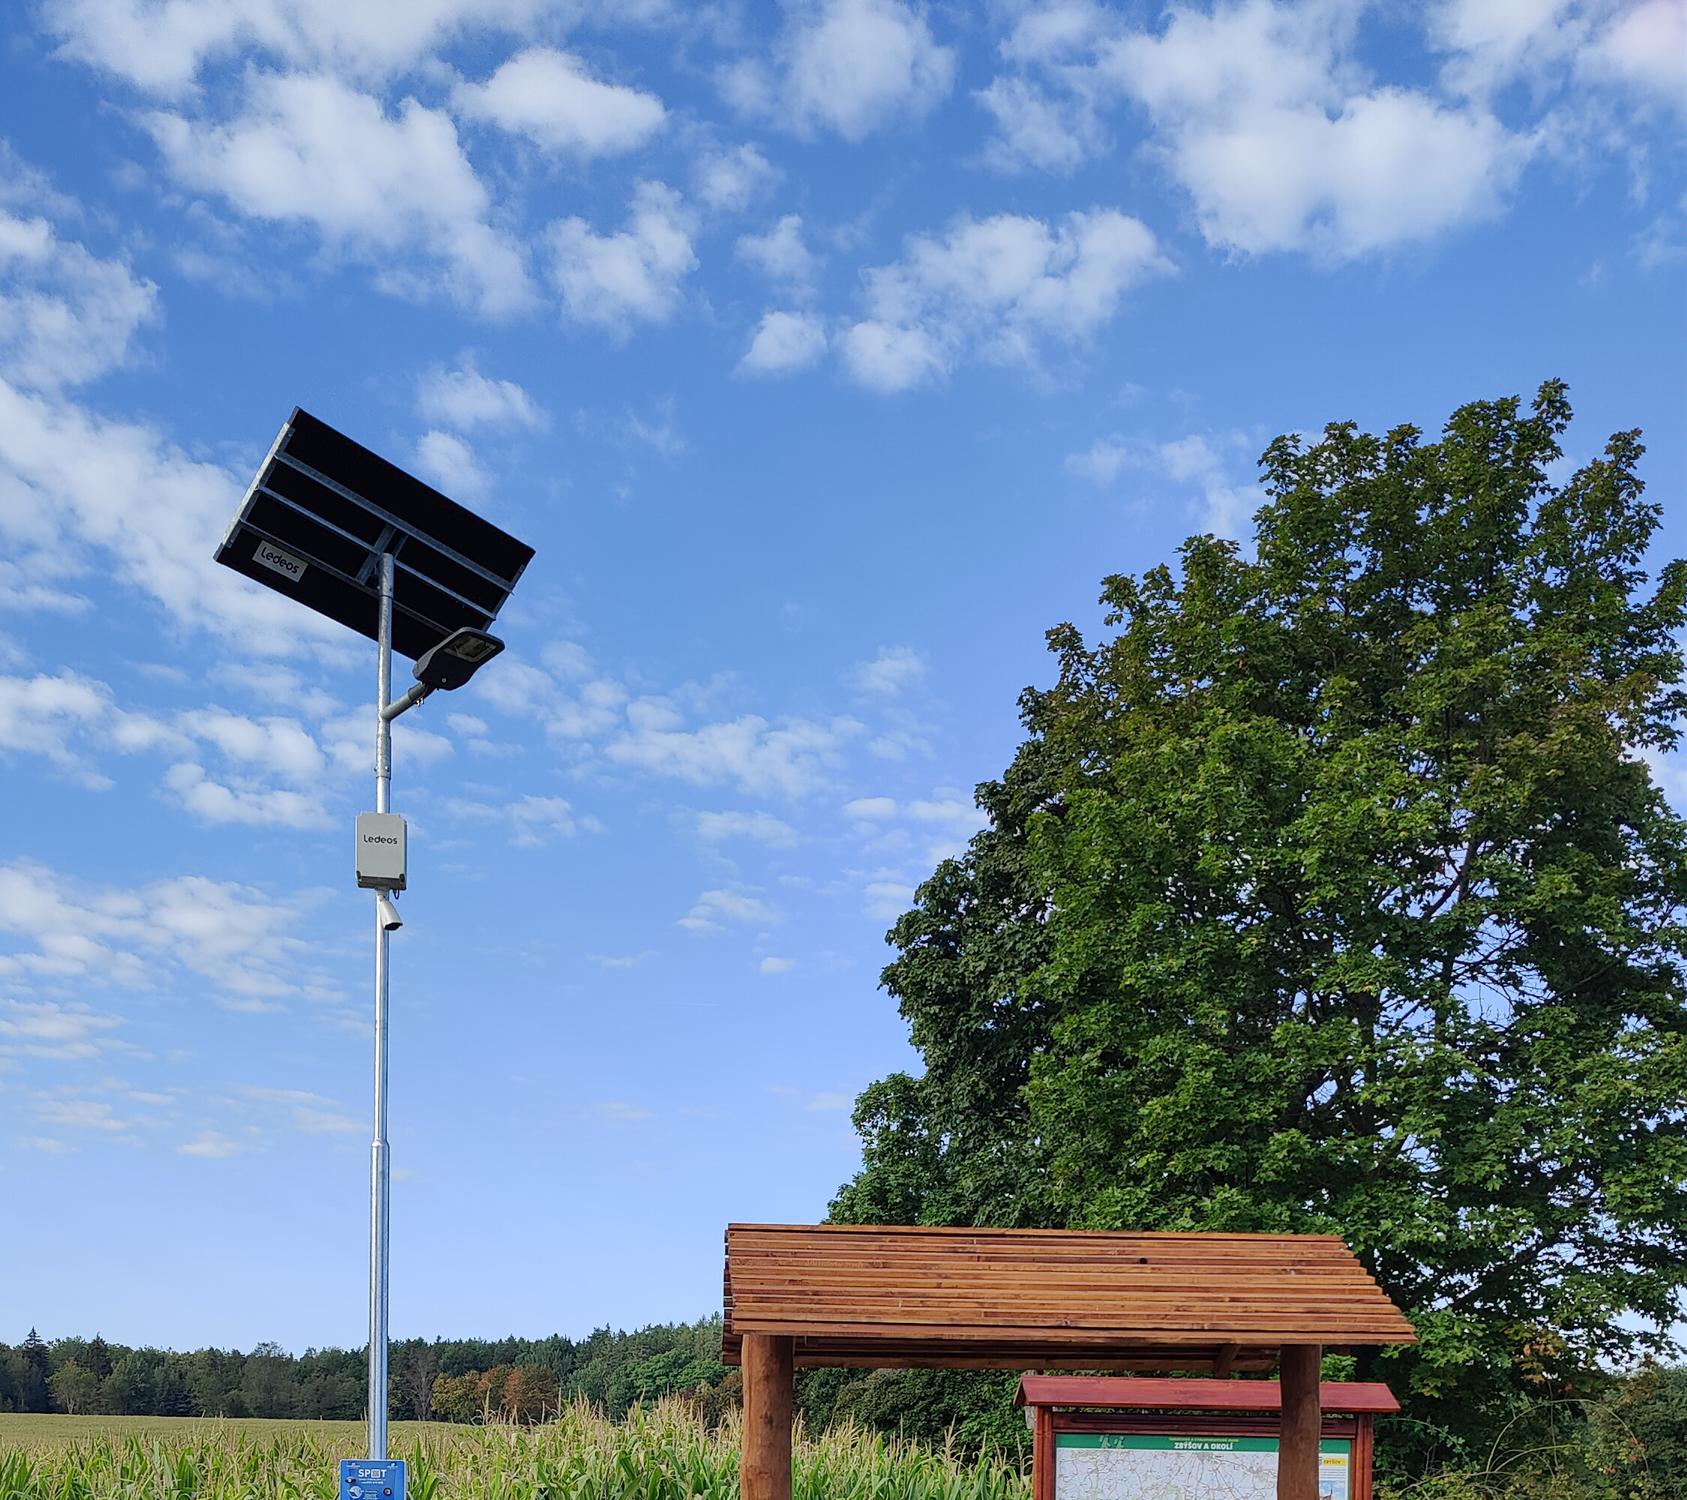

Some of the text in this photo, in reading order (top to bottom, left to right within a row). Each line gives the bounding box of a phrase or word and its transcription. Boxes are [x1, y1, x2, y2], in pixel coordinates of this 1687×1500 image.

[261, 547, 299, 573] Ledeos
[363, 834, 398, 845] Ledeos
[1210, 1442, 1233, 1450] OKOLÍ
